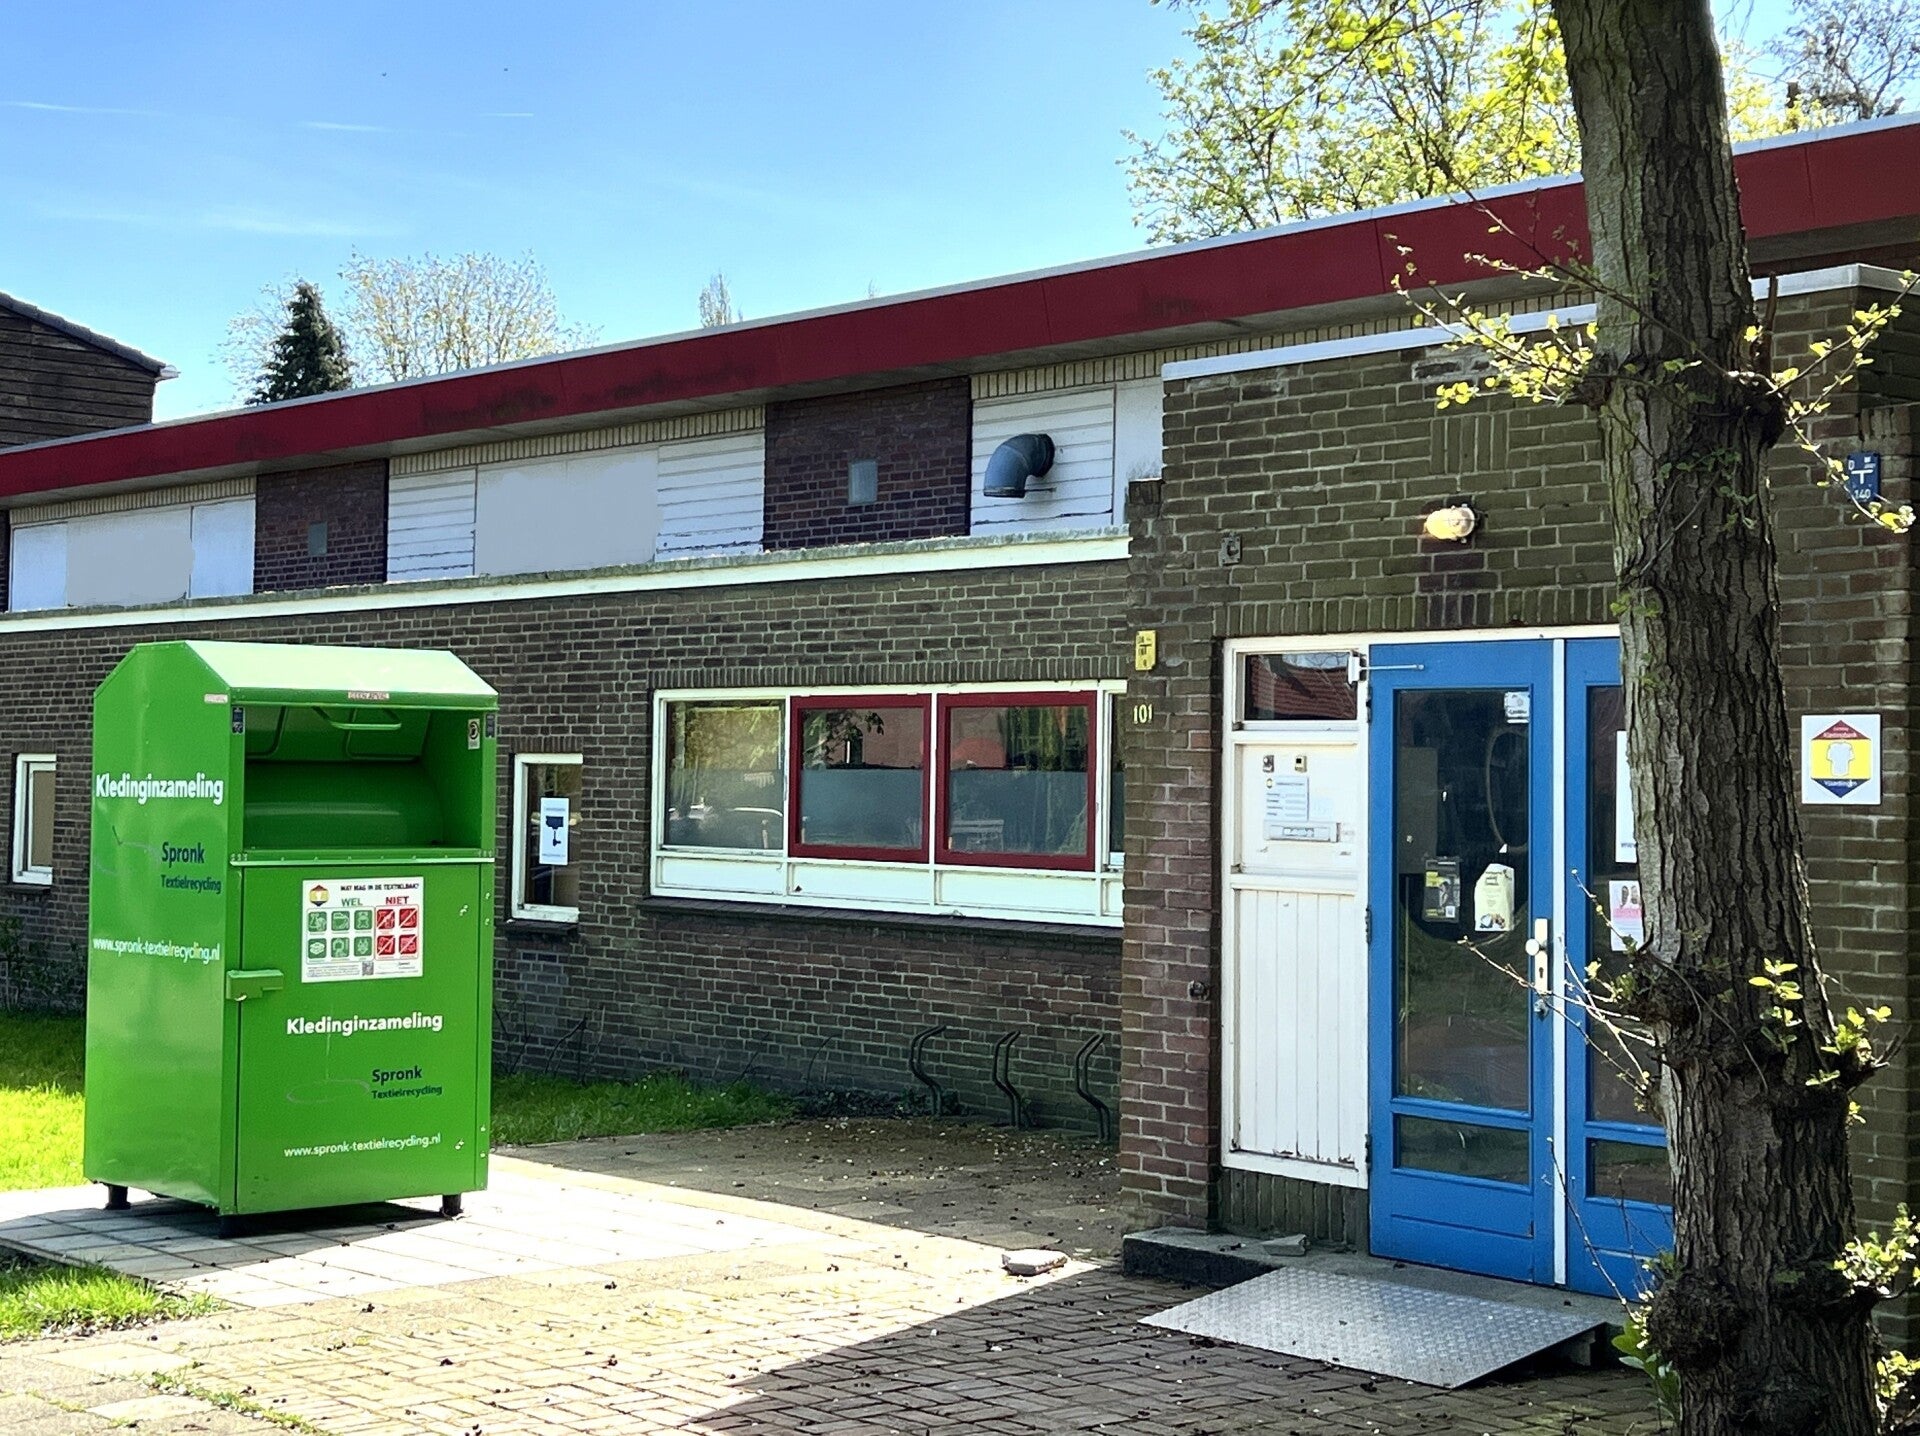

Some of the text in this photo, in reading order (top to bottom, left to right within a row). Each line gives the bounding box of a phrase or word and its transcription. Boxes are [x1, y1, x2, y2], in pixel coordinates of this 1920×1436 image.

[1854, 488, 1871, 499] 140
[1133, 703, 1152, 725] 101
[96, 772, 224, 805] Kledinginzameling
[161, 841, 205, 868] Spronk
[161, 874, 222, 895] Textielrecycling
[341, 898, 363, 906] WEL
[385, 896, 409, 905] NIET
[93, 937, 220, 964] www.spronk-textielrecycling.nl
[287, 1012, 443, 1036] Kledinginzameling
[371, 1065, 422, 1086] Spronk
[371, 1085, 443, 1099] Textielrecycling
[284, 1133, 441, 1156] www.spronk-textielrecycling.nl
